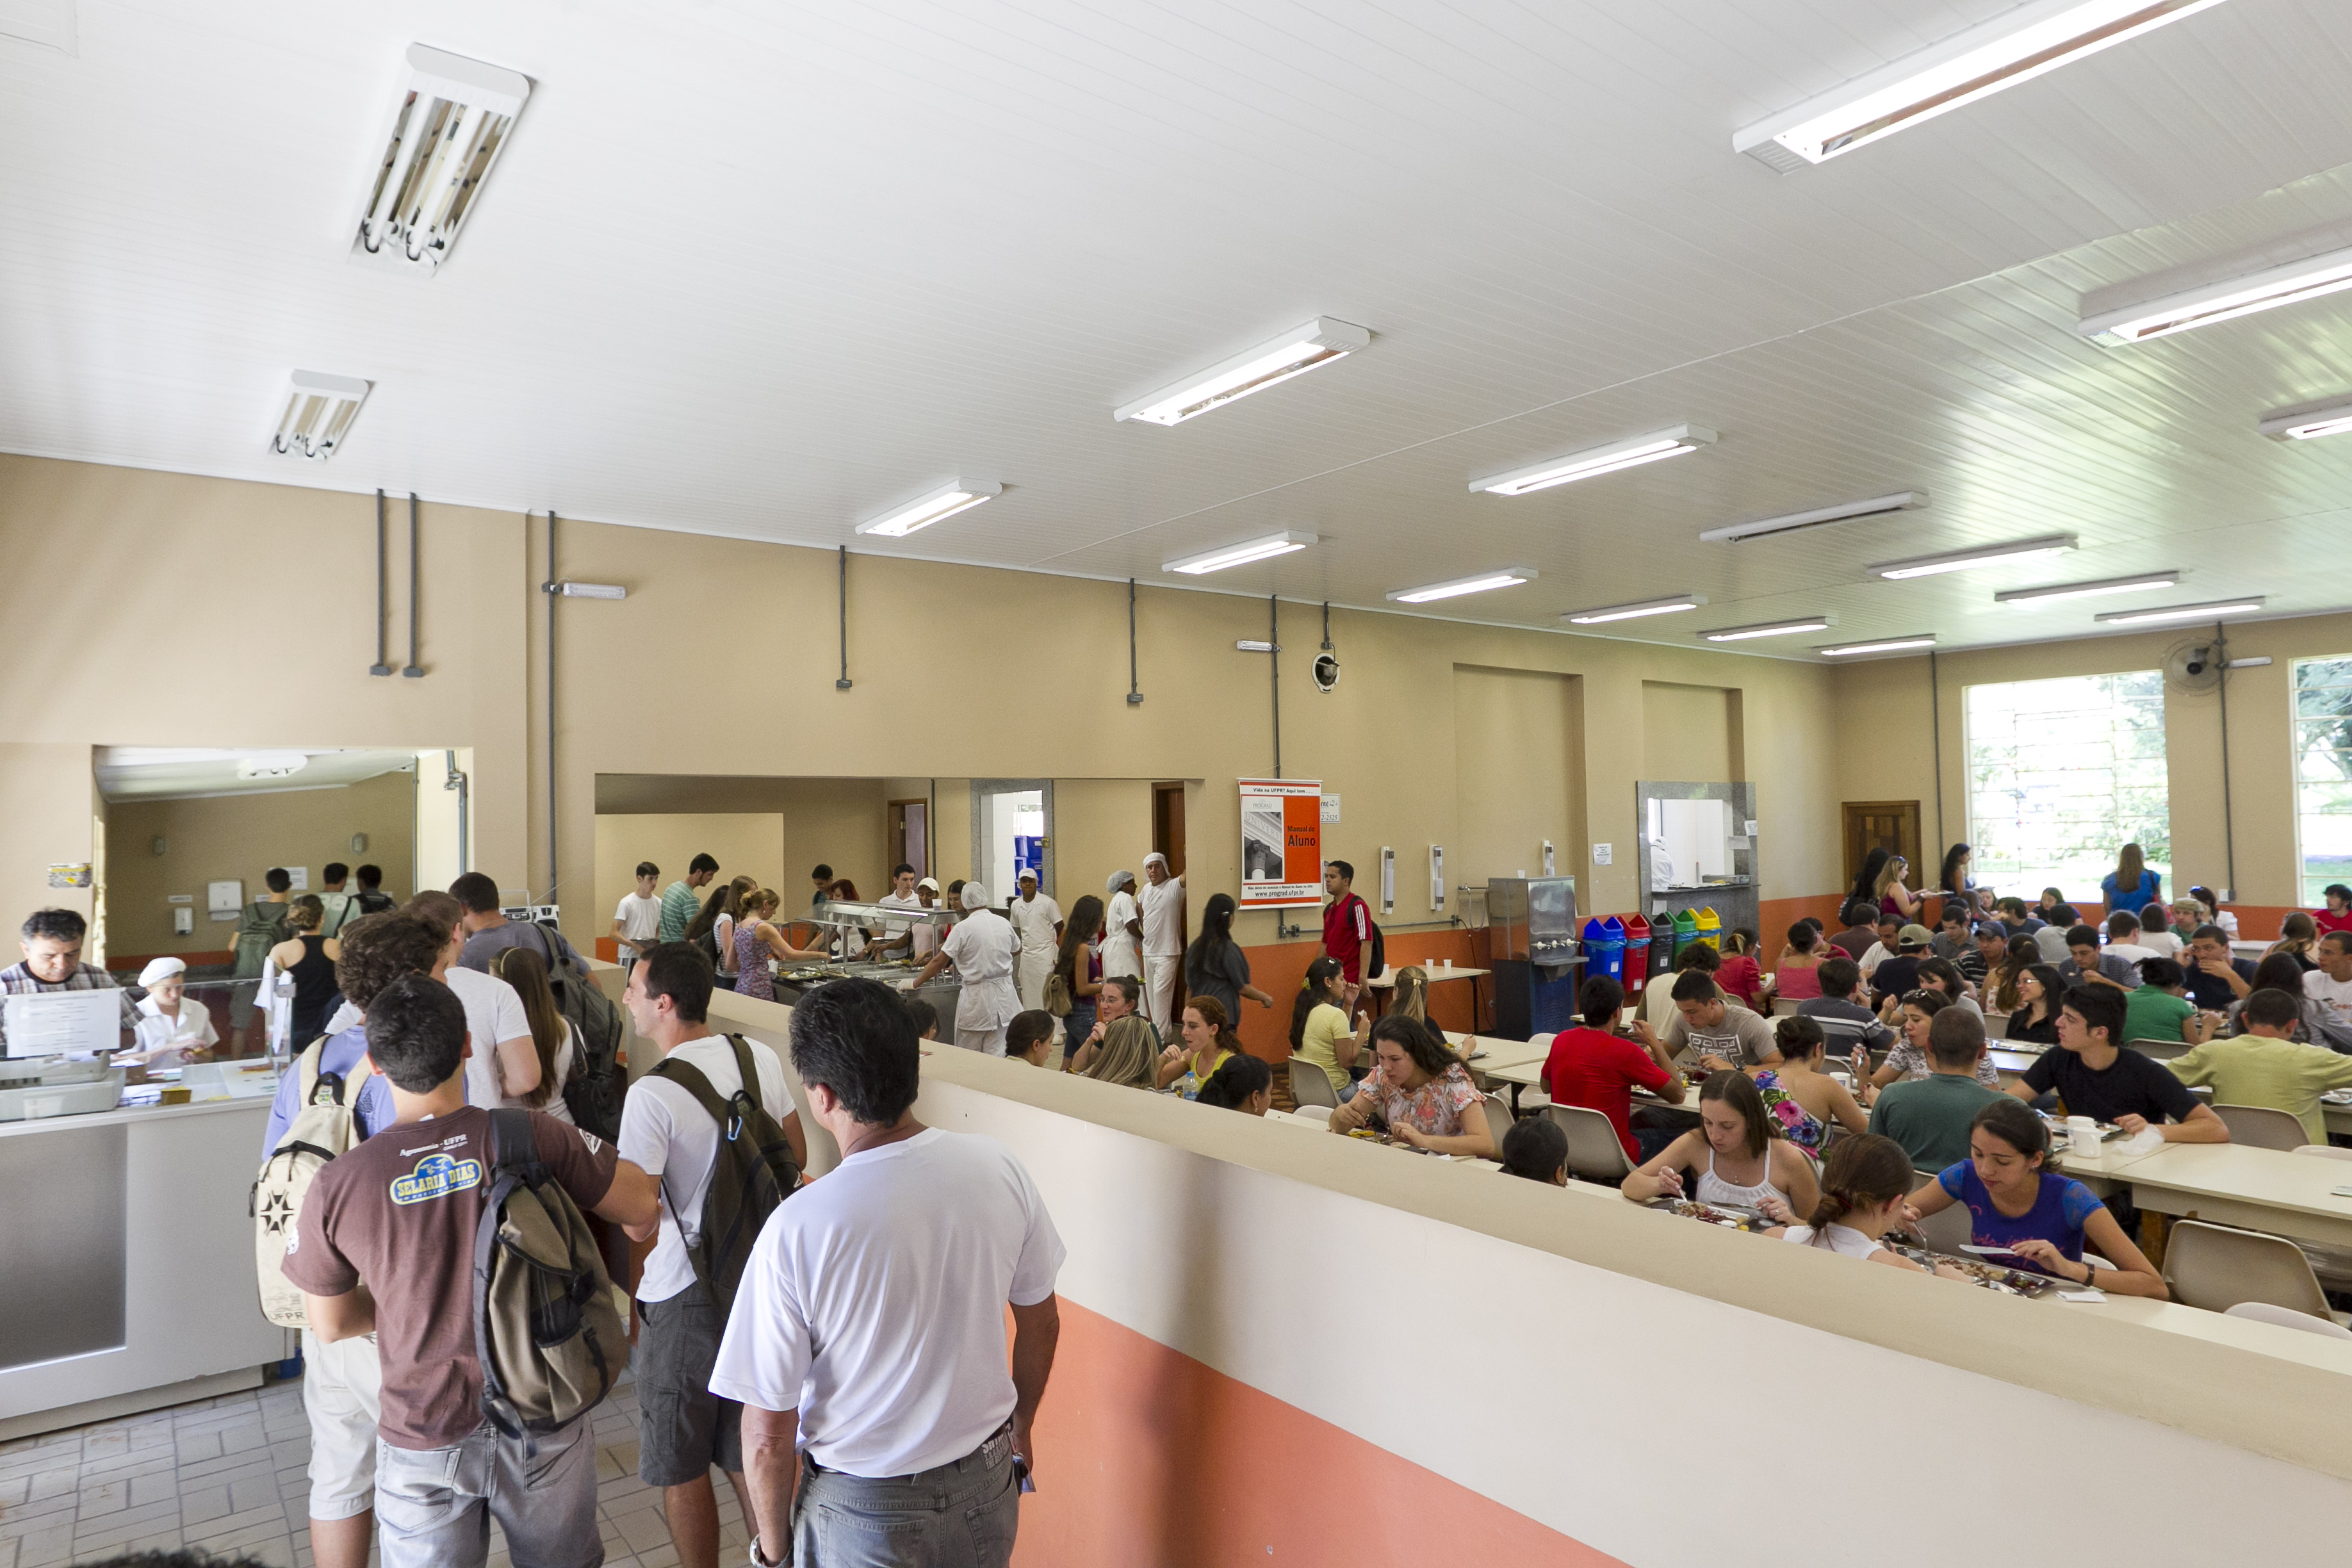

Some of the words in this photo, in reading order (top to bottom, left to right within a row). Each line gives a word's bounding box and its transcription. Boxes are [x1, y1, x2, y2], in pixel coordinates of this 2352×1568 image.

[1287, 835, 1316, 846] Aluno
[443, 1134, 467, 1146] UFPR
[397, 1173, 446, 1197] SELARIA
[448, 1164, 475, 1184] DIAS
[268, 1311, 305, 1320] UFPR
